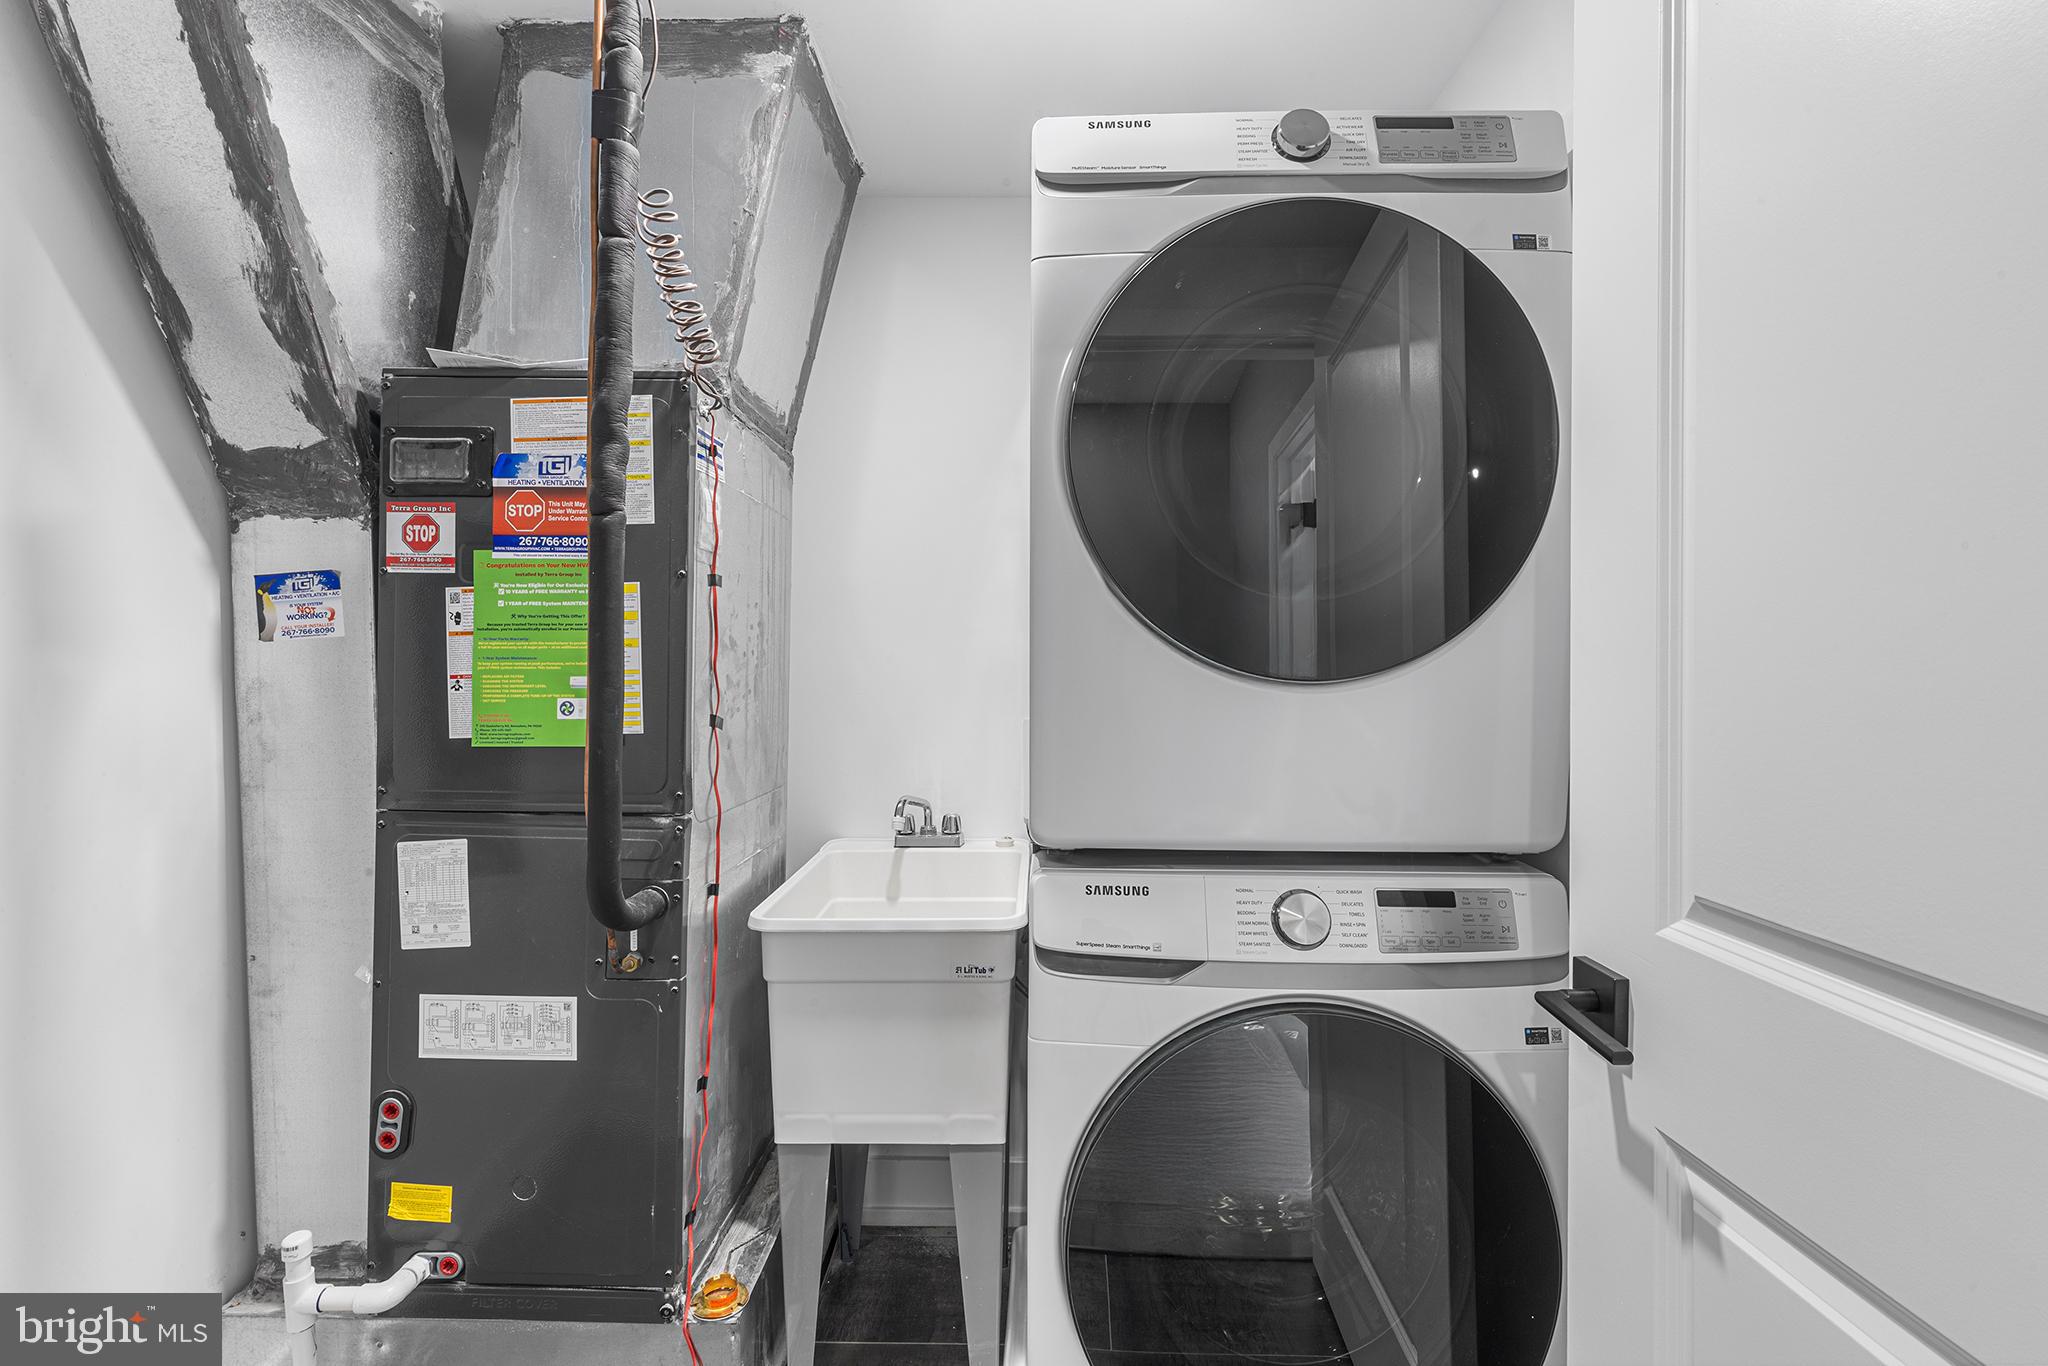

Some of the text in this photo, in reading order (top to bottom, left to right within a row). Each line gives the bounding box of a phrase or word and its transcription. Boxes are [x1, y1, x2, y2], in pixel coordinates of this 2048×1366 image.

[1088, 120, 1151, 130] SAMSUNG
[508, 504, 543, 517] STOP
[405, 524, 436, 542] STOP
[297, 606, 316, 614] NOT
[286, 611, 328, 621] WORKING?
[1085, 885, 1149, 896] SAMSUNG
[472, 1297, 559, 1310] FILTER COVER
